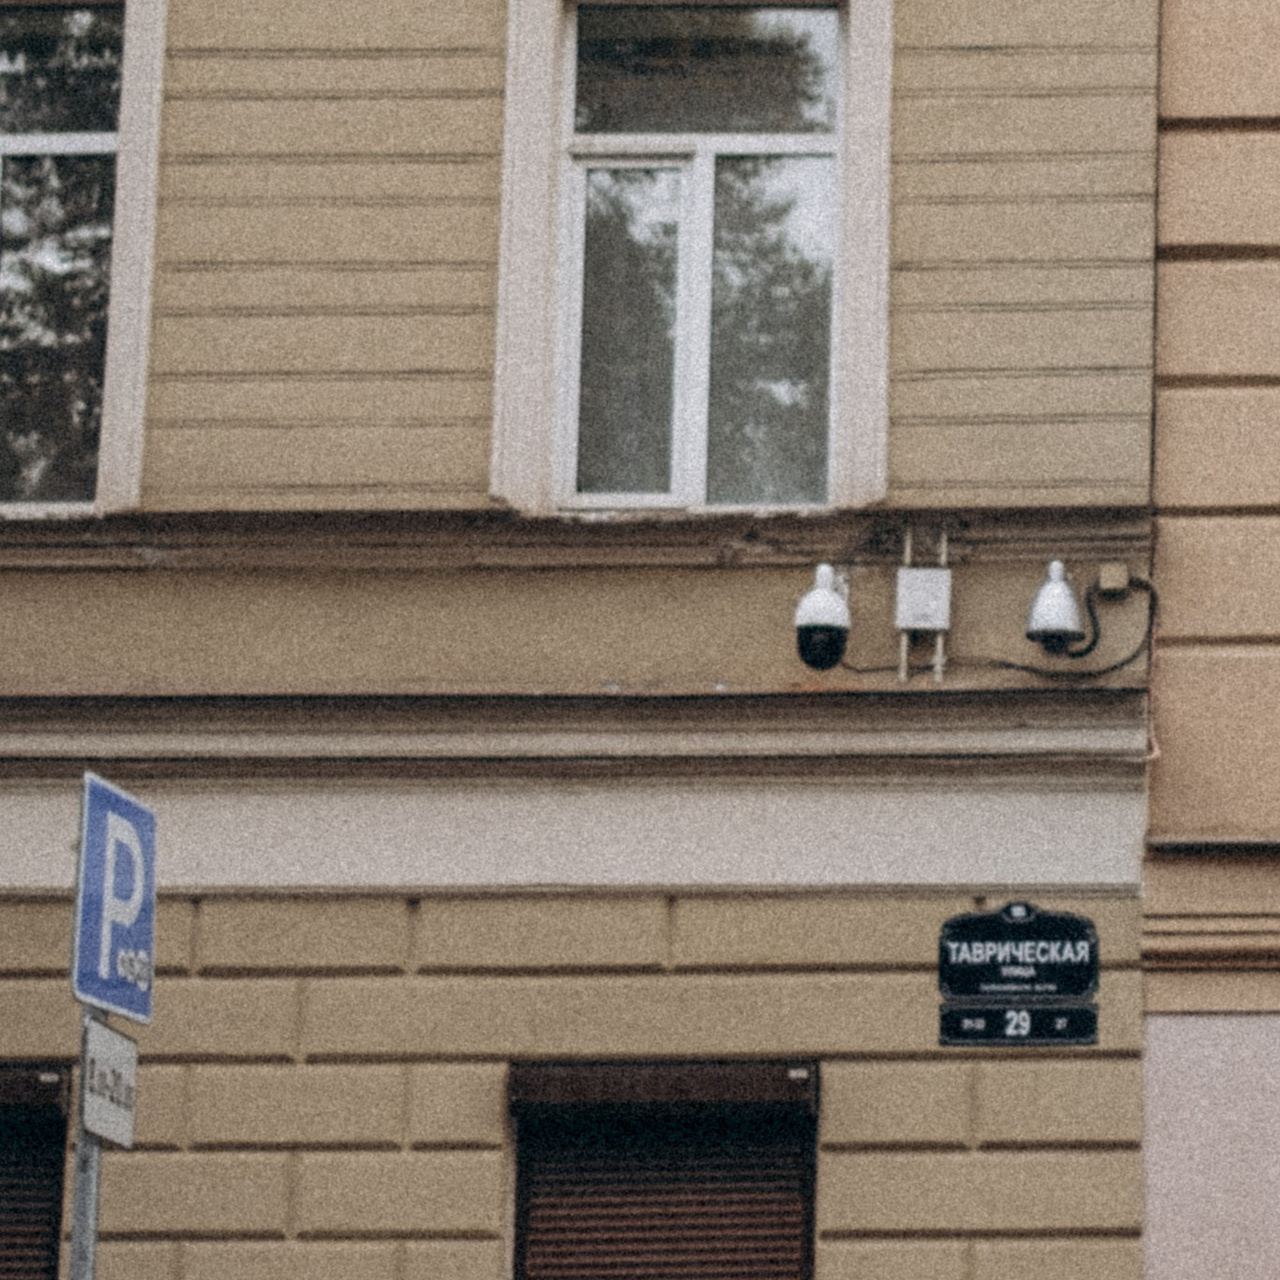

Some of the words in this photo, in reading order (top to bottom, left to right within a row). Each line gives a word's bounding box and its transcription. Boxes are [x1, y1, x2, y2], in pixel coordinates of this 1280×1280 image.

[98, 812, 143, 980] P
[947, 941, 1090, 963] ТАВРИЧЕСКАЯ
[1004, 1010, 1031, 1036] 29
